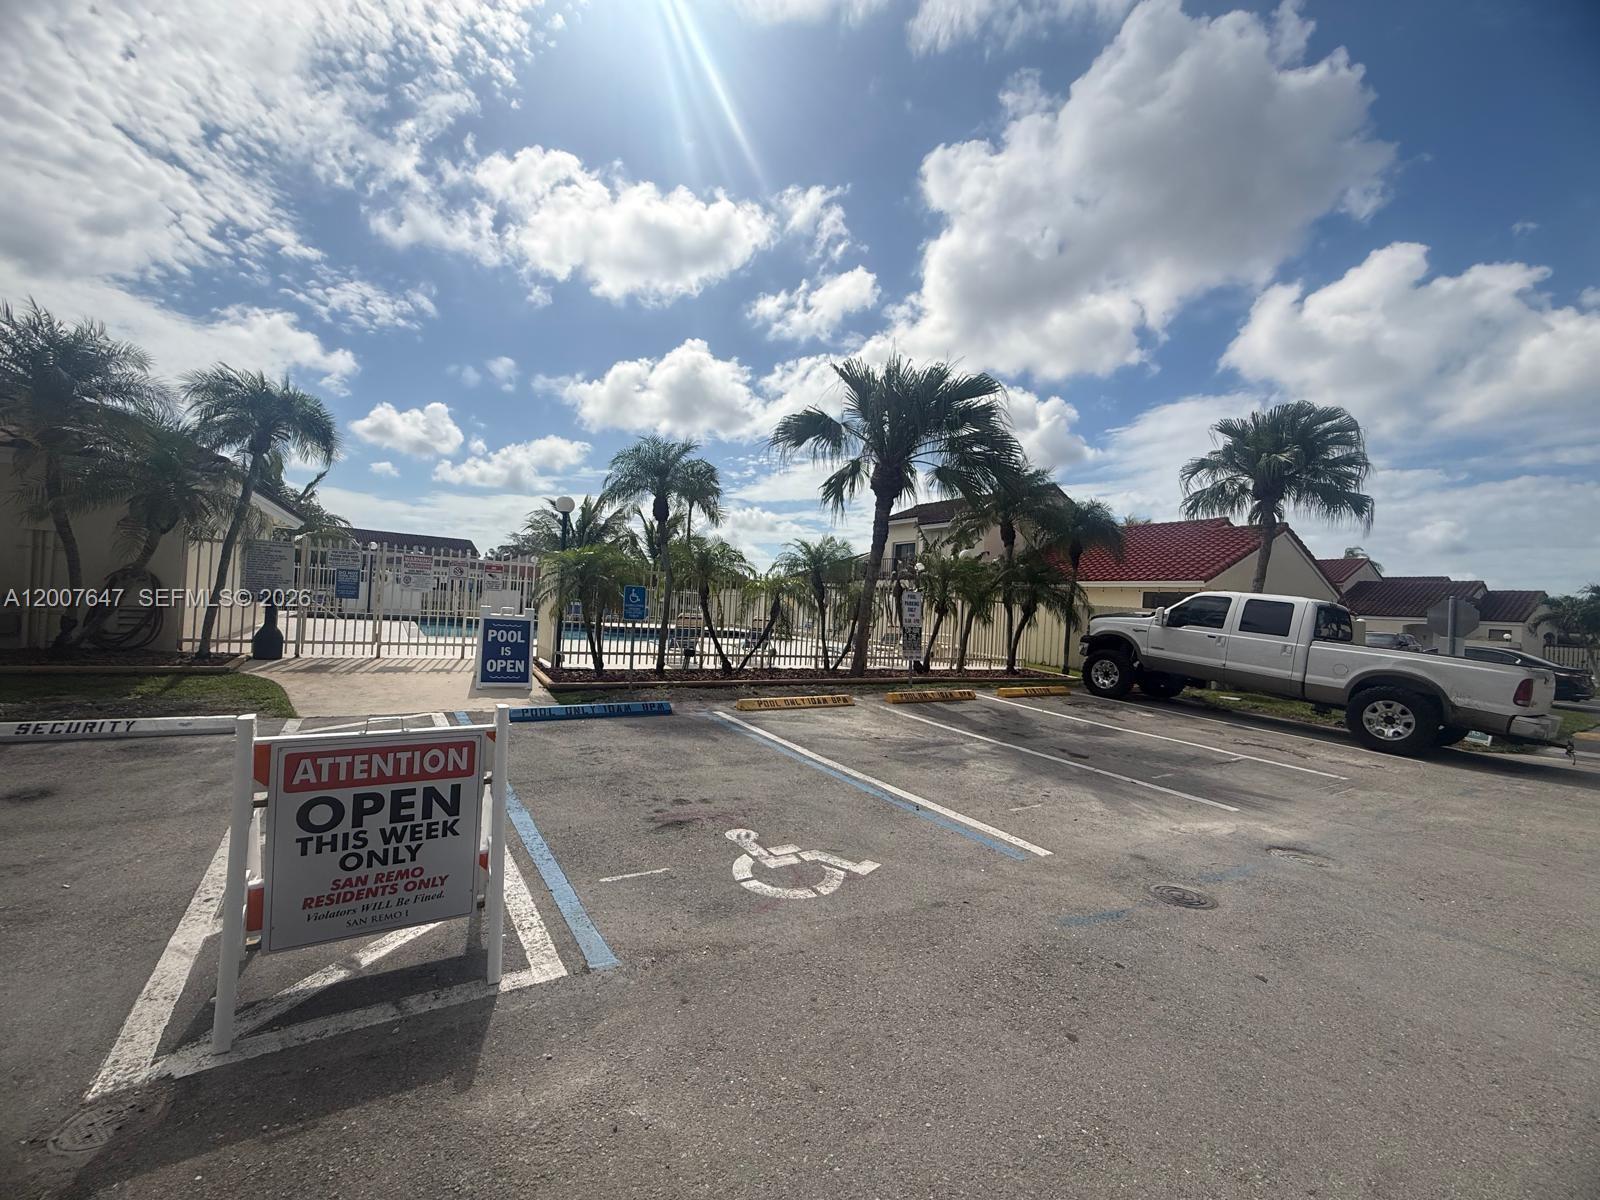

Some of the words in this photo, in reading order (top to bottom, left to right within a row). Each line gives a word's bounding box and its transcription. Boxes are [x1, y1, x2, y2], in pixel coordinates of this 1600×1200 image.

[488, 629, 526, 643] POOL
[500, 646, 512, 656] IS
[486, 659, 525, 673] OPEN
[521, 706, 556, 718] POOL
[565, 704, 597, 717] ONLY
[757, 699, 782, 708] POOL
[784, 698, 806, 707] ONLY
[14, 720, 137, 735] SECURITY
[292, 746, 469, 785] ATTENTION
[296, 783, 462, 834] OPEN
[296, 829, 369, 857] THIS
[380, 818, 461, 846] WEEK
[338, 842, 424, 872] ONLY
[330, 874, 370, 891] SAN
[374, 866, 425, 885] REMO
[302, 882, 399, 910] RESIDENTS
[404, 874, 450, 893] ONLY
[306, 906, 358, 923] Violators
[361, 900, 393, 913] WILL
[397, 897, 411, 907] Be
[346, 916, 367, 929] SAN
[371, 911, 403, 924] REMO
